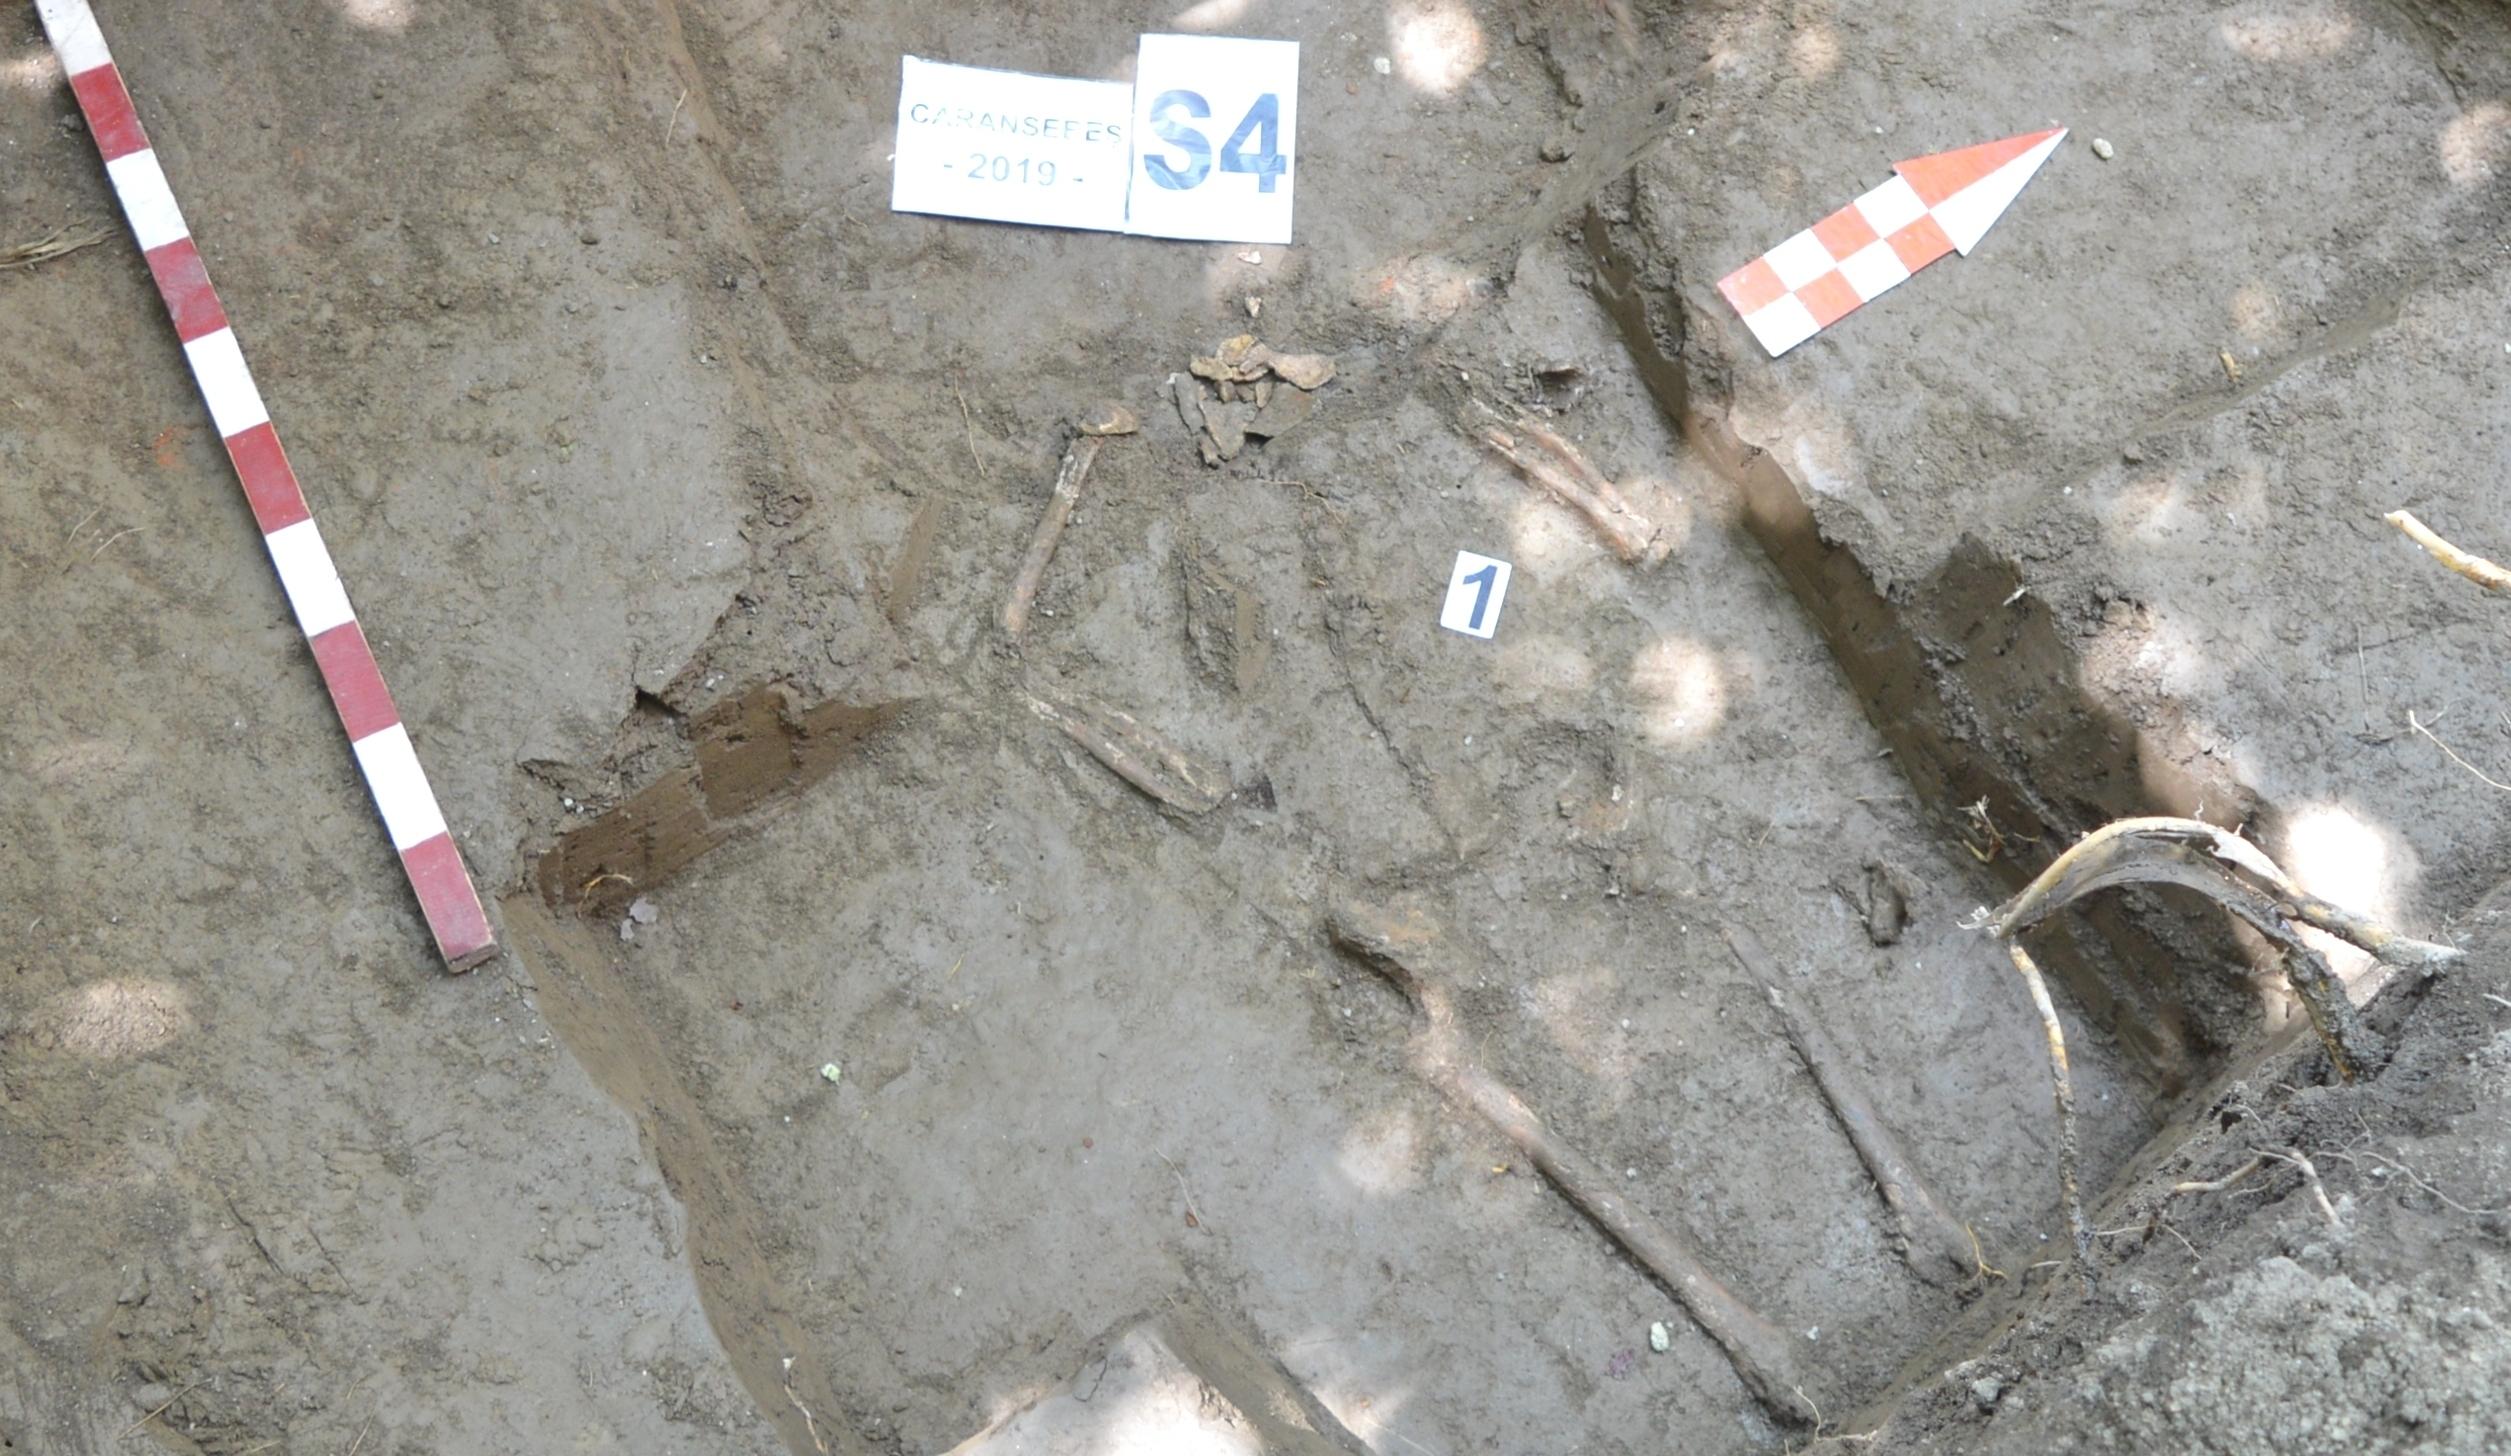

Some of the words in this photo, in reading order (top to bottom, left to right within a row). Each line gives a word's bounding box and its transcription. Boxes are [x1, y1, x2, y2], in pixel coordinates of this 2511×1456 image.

[967, 153, 1057, 187] 2019
[1143, 89, 1287, 193] S4
[1462, 564, 1498, 630] 1
